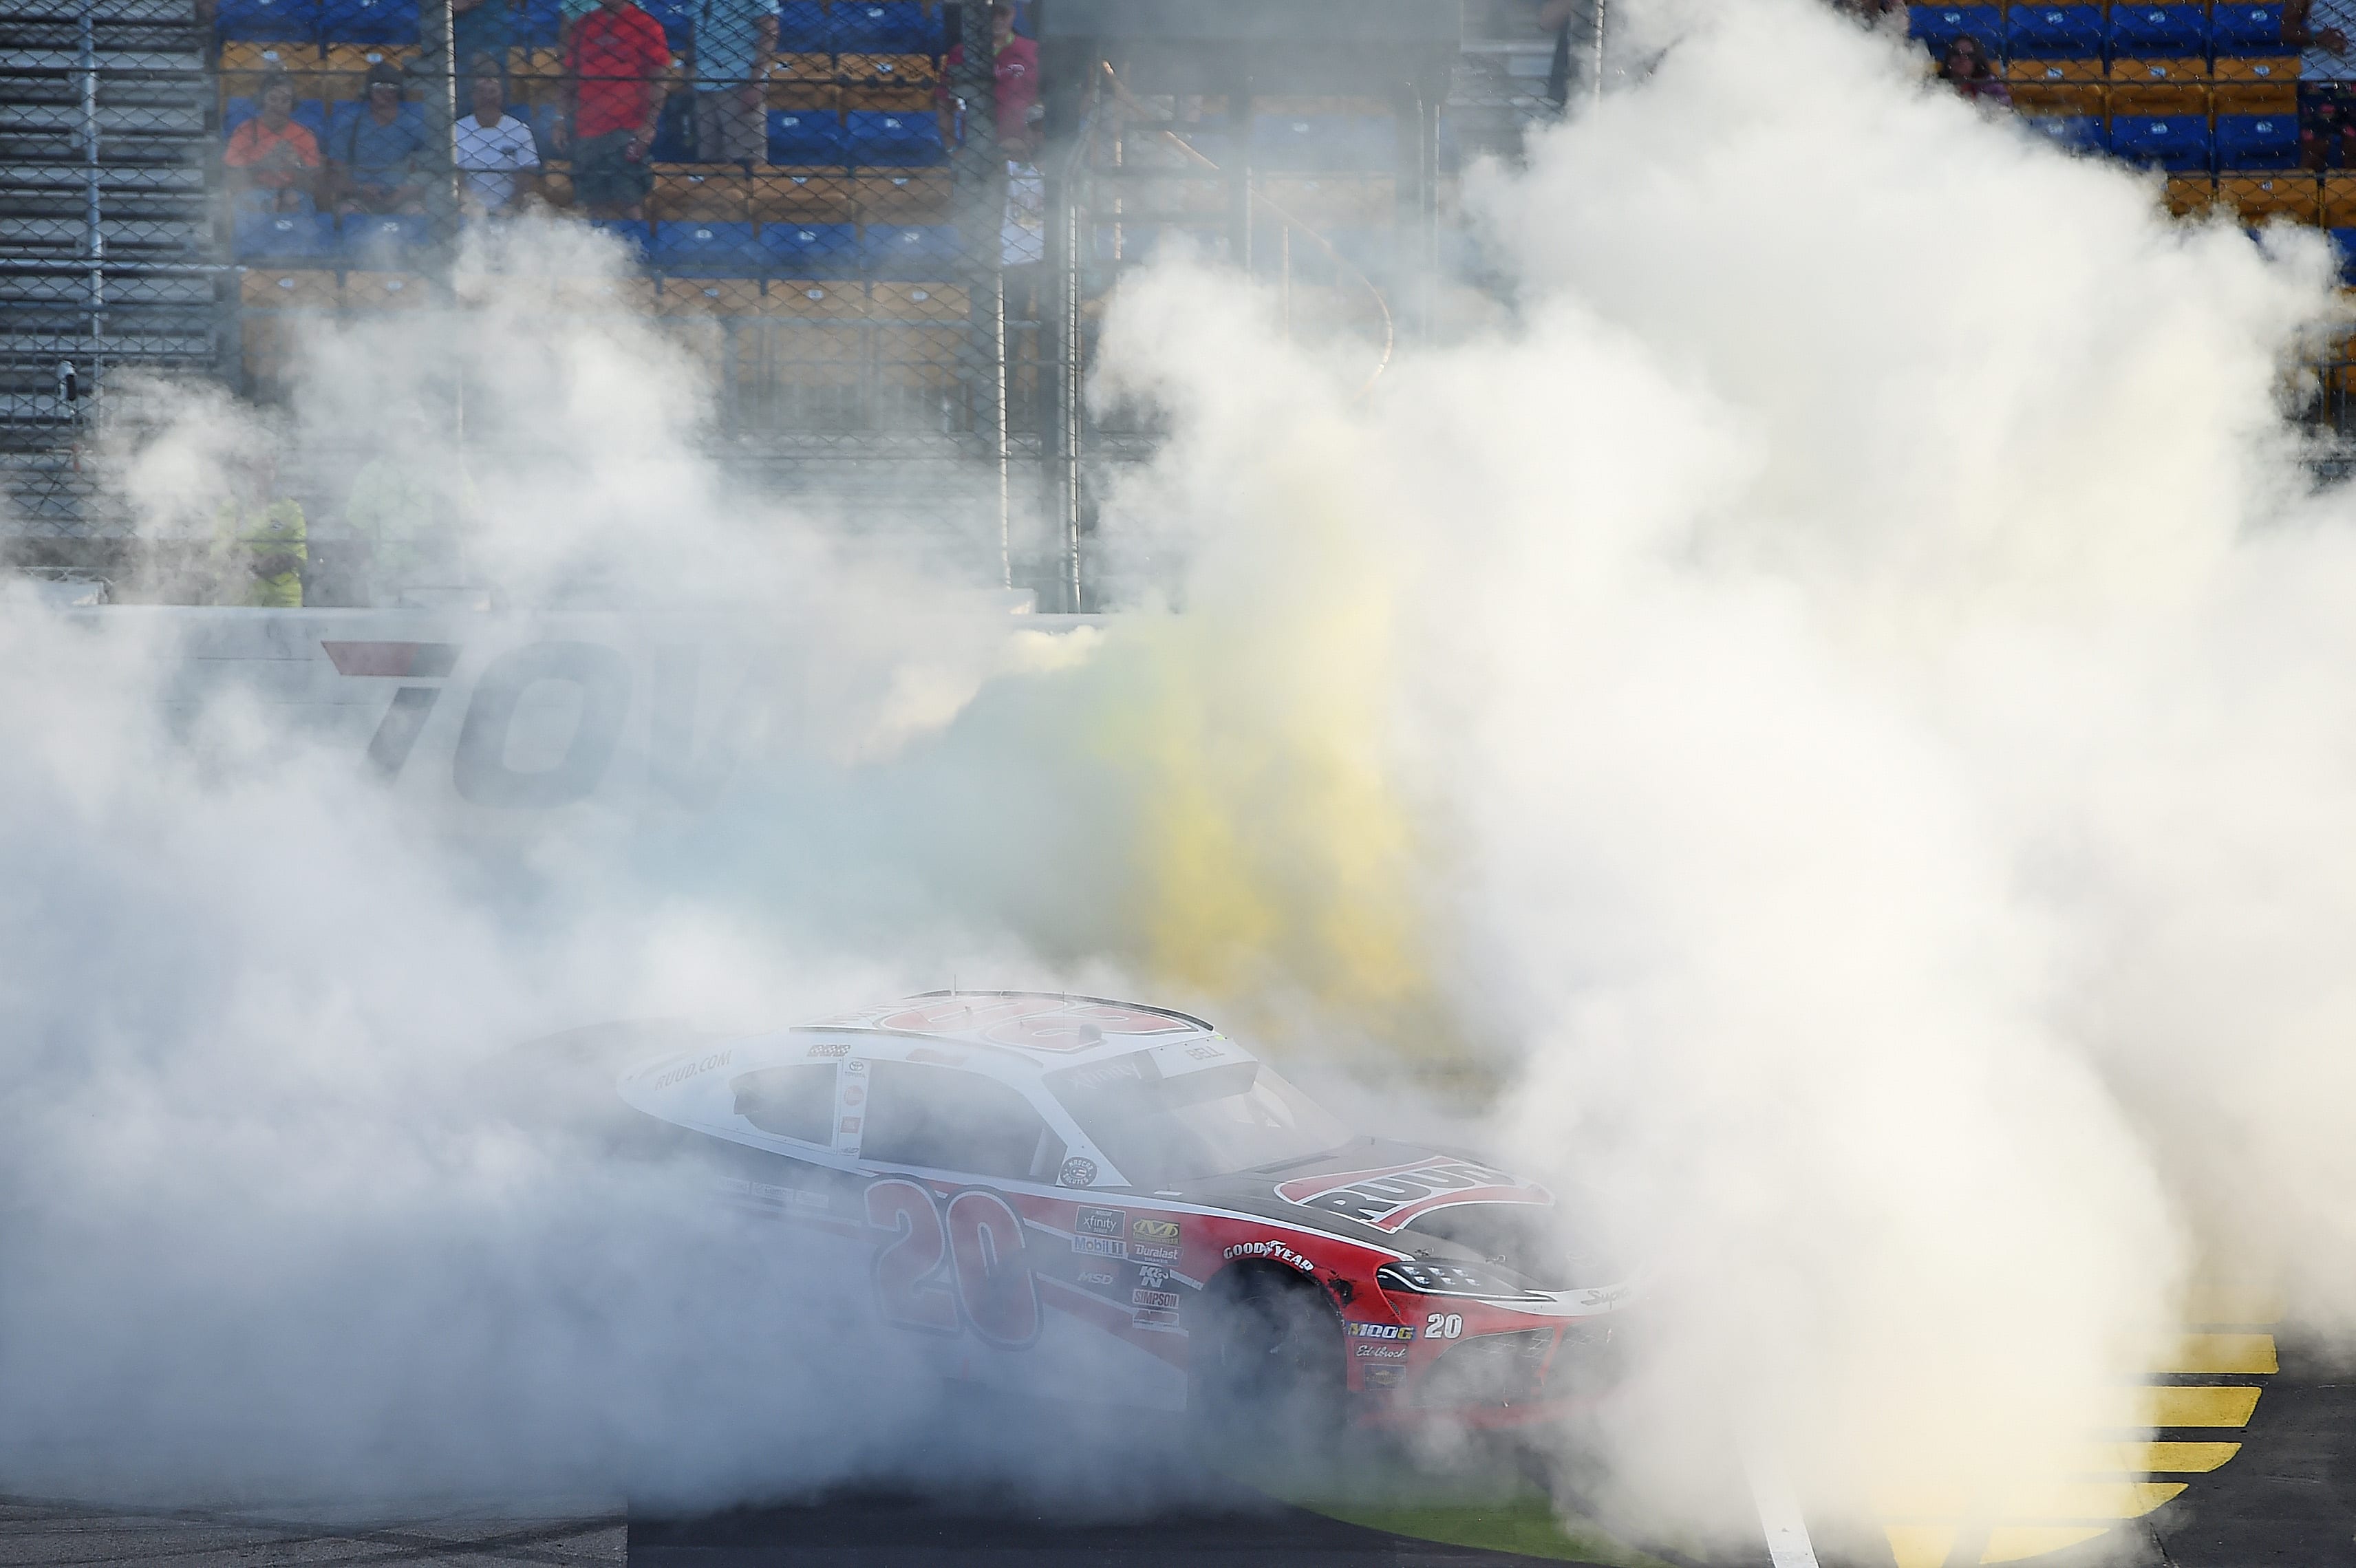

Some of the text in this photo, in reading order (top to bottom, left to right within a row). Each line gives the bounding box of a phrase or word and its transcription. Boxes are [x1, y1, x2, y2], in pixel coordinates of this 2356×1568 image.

[654, 1049, 732, 1091] RUUD.COM
[1303, 1164, 1517, 1221] RUUD
[1084, 1215, 1117, 1232] xfinity
[1135, 1244, 1179, 1260] Duralast
[864, 1175, 1042, 1349] 20
[1077, 1272, 1114, 1285] MSD
[1135, 1290, 1177, 1307] SIMPSON
[1348, 1322, 1414, 1340] MOOG
[1424, 1313, 1464, 1339] 20
[1356, 1344, 1406, 1358] Edelbrock
